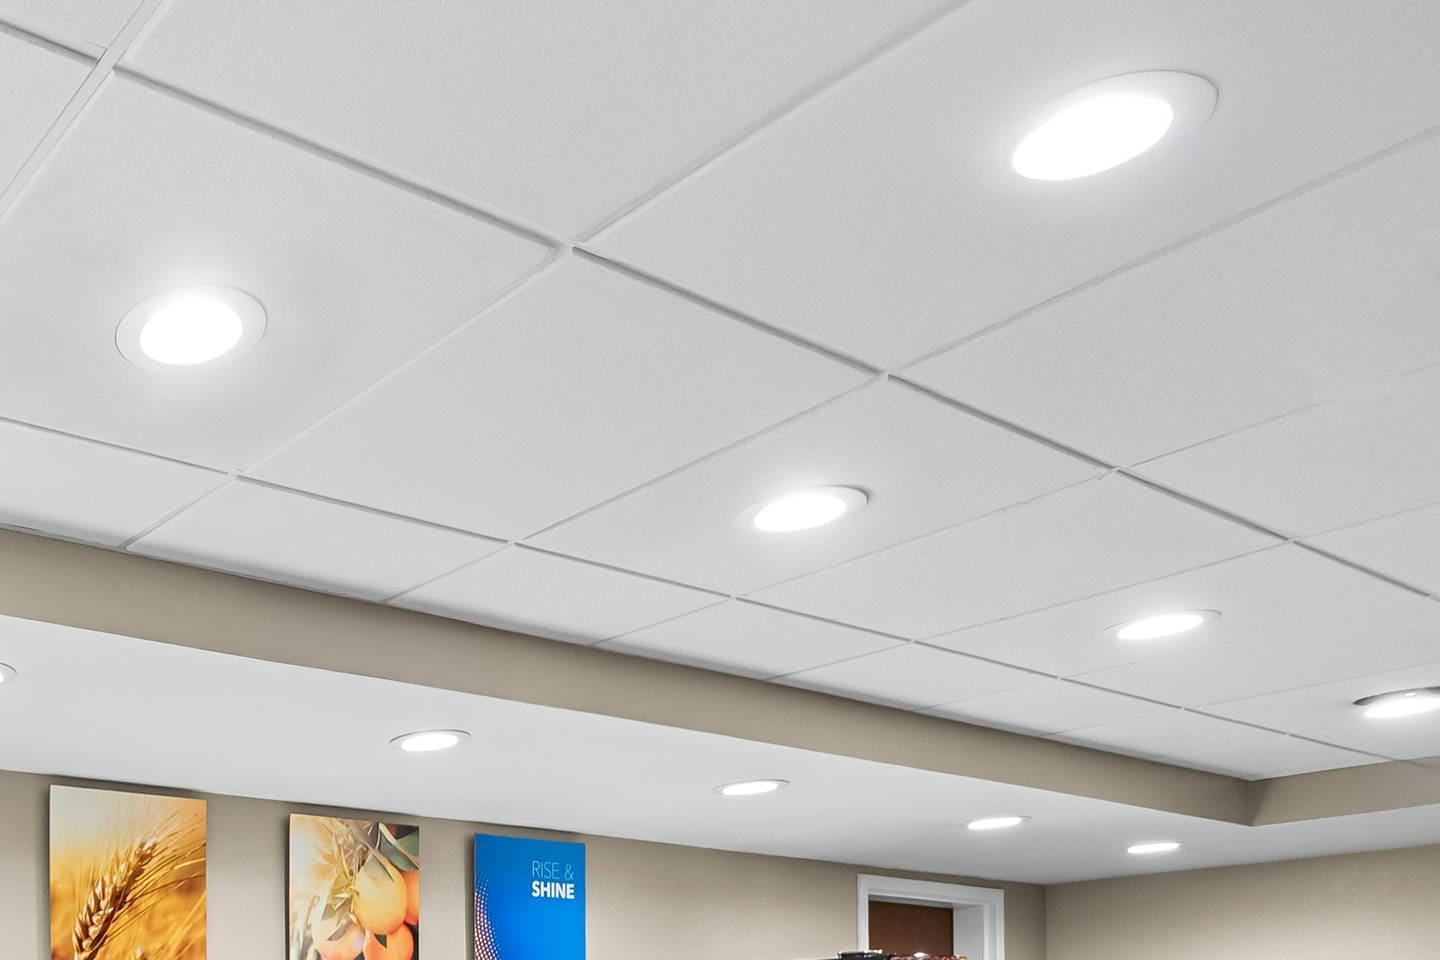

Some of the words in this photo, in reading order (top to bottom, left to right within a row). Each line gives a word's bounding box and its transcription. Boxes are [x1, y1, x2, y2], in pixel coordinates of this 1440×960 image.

[532, 860, 561, 880] RISE
[564, 863, 575, 881] &
[531, 880, 575, 899] SHINE
